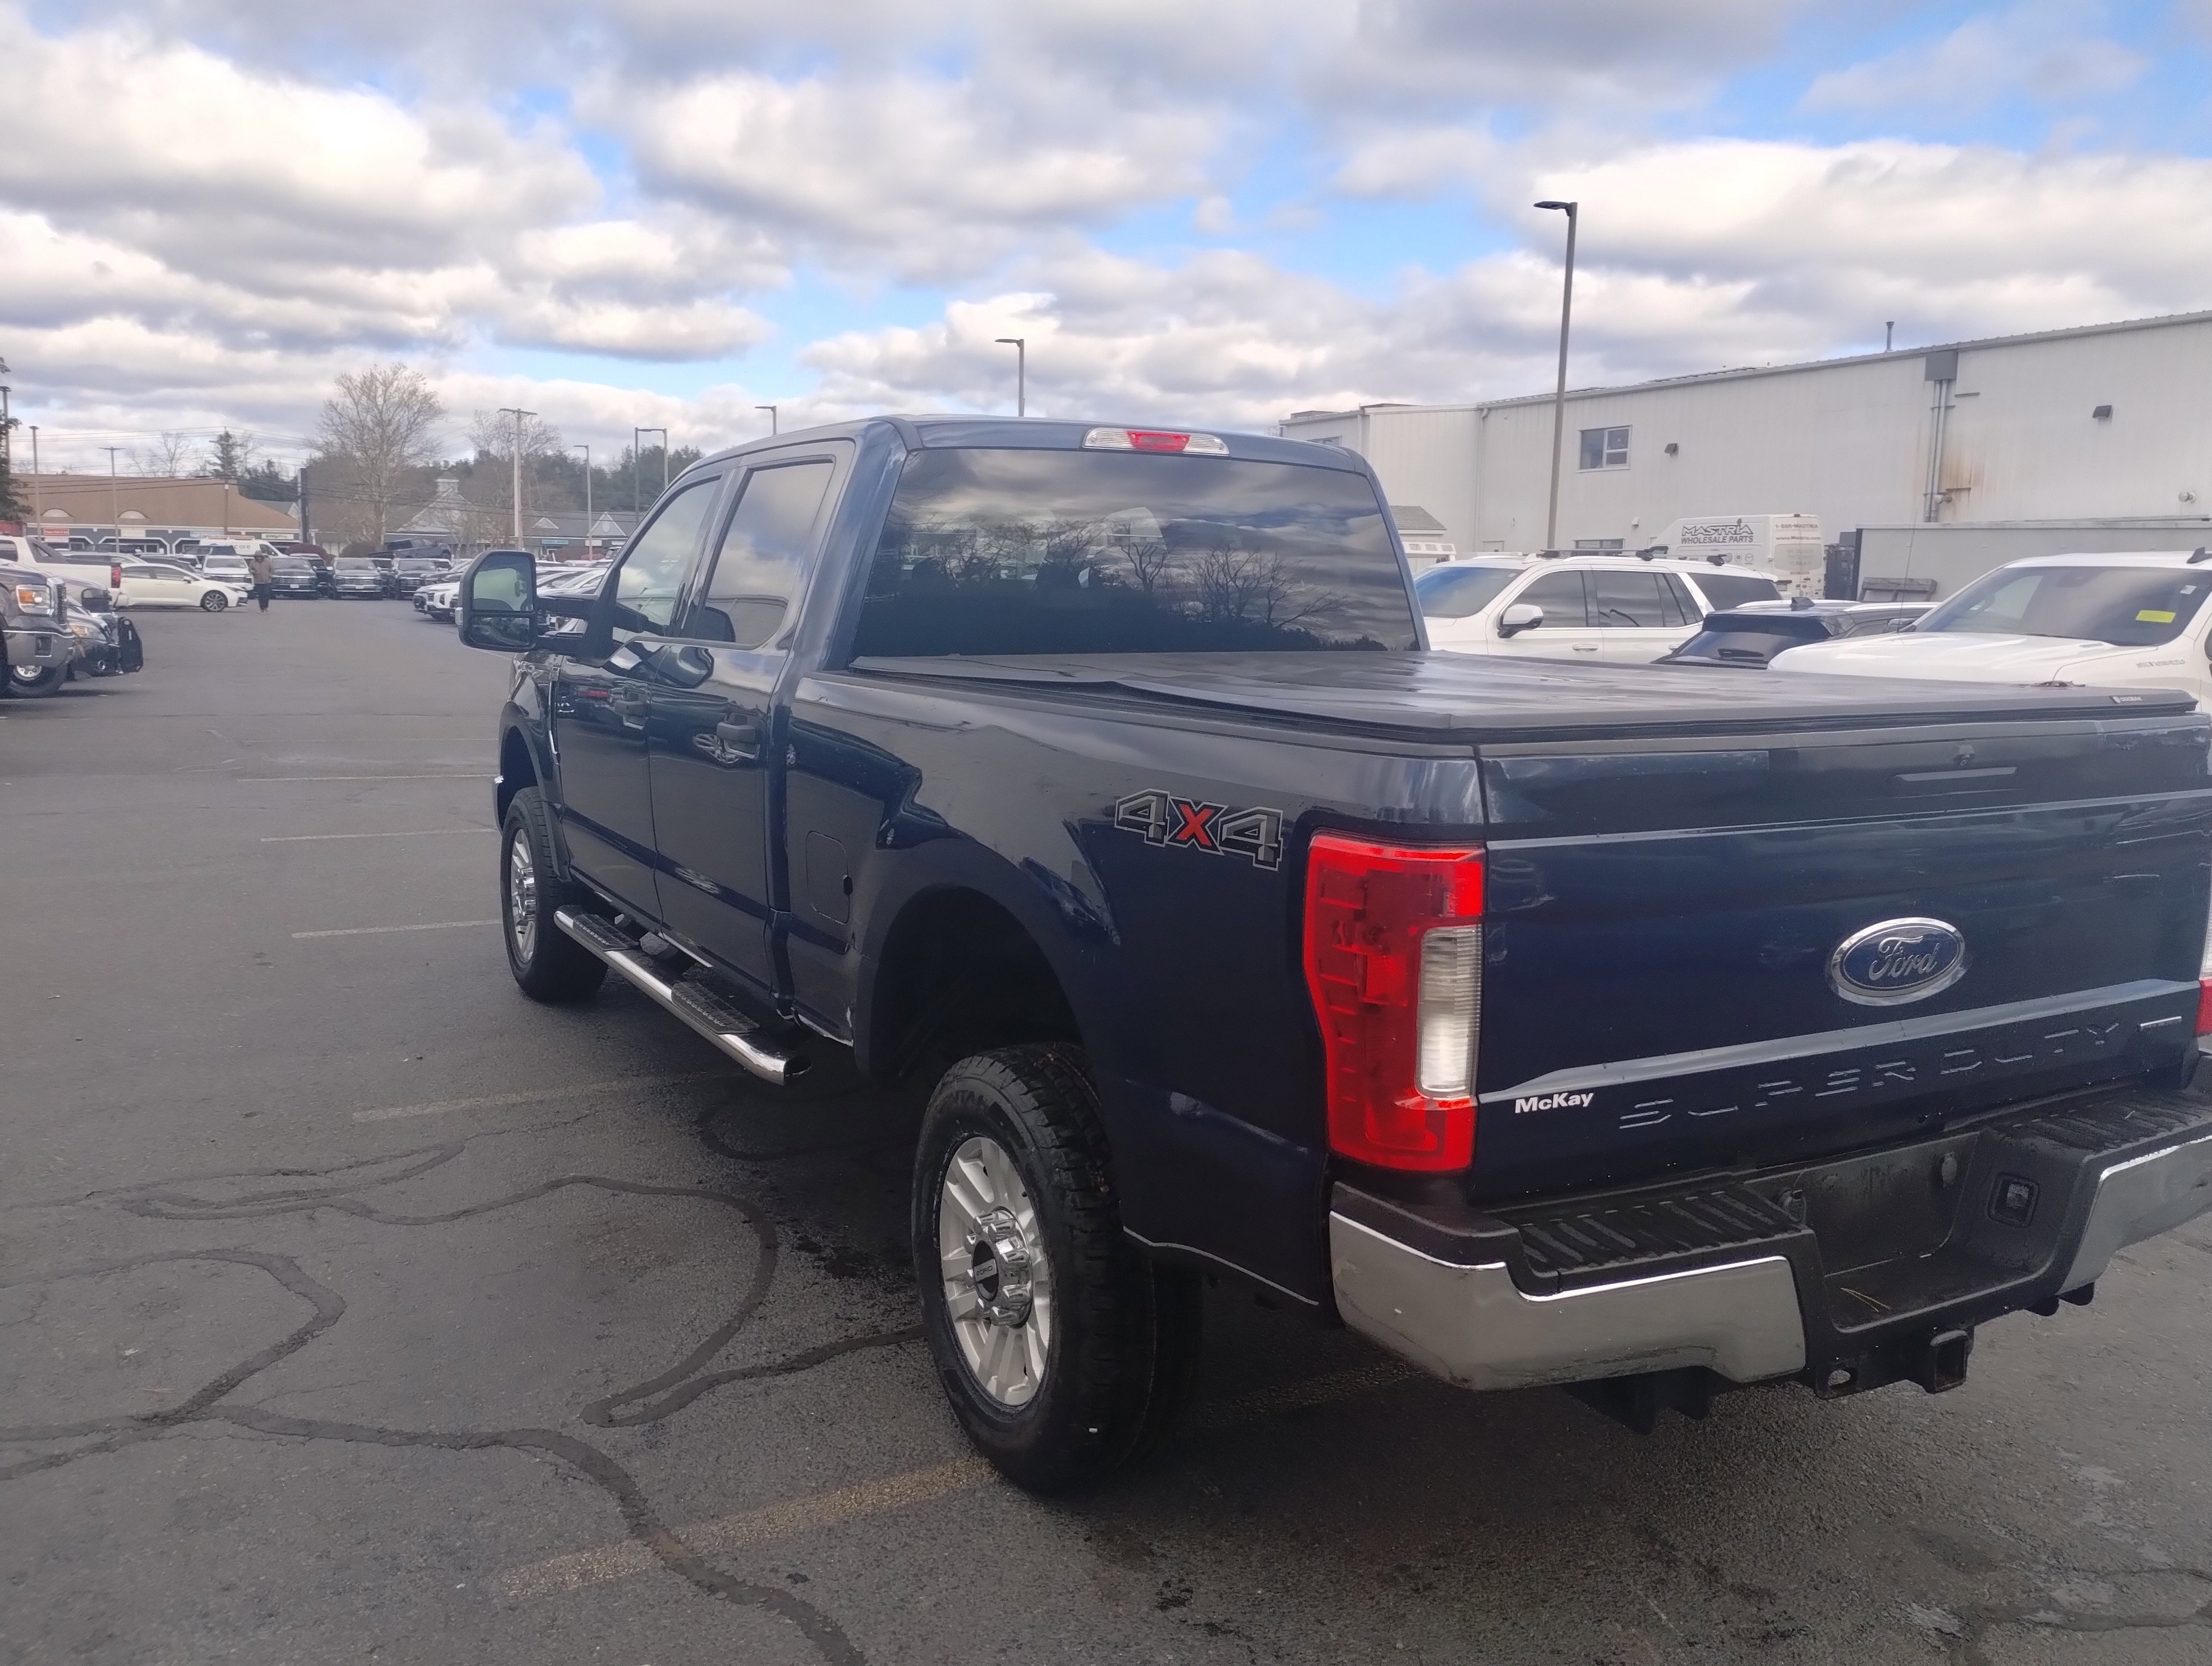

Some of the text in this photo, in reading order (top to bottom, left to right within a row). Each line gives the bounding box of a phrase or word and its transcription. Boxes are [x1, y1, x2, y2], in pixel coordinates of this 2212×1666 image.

[1681, 521, 1753, 536] MASTRIA
[1681, 536, 1727, 544] WHOLESALE
[1868, 935, 1940, 981] Ford
[1618, 1022, 2120, 1130] SUPER DUTY
[1515, 1092, 1594, 1114] McKay
